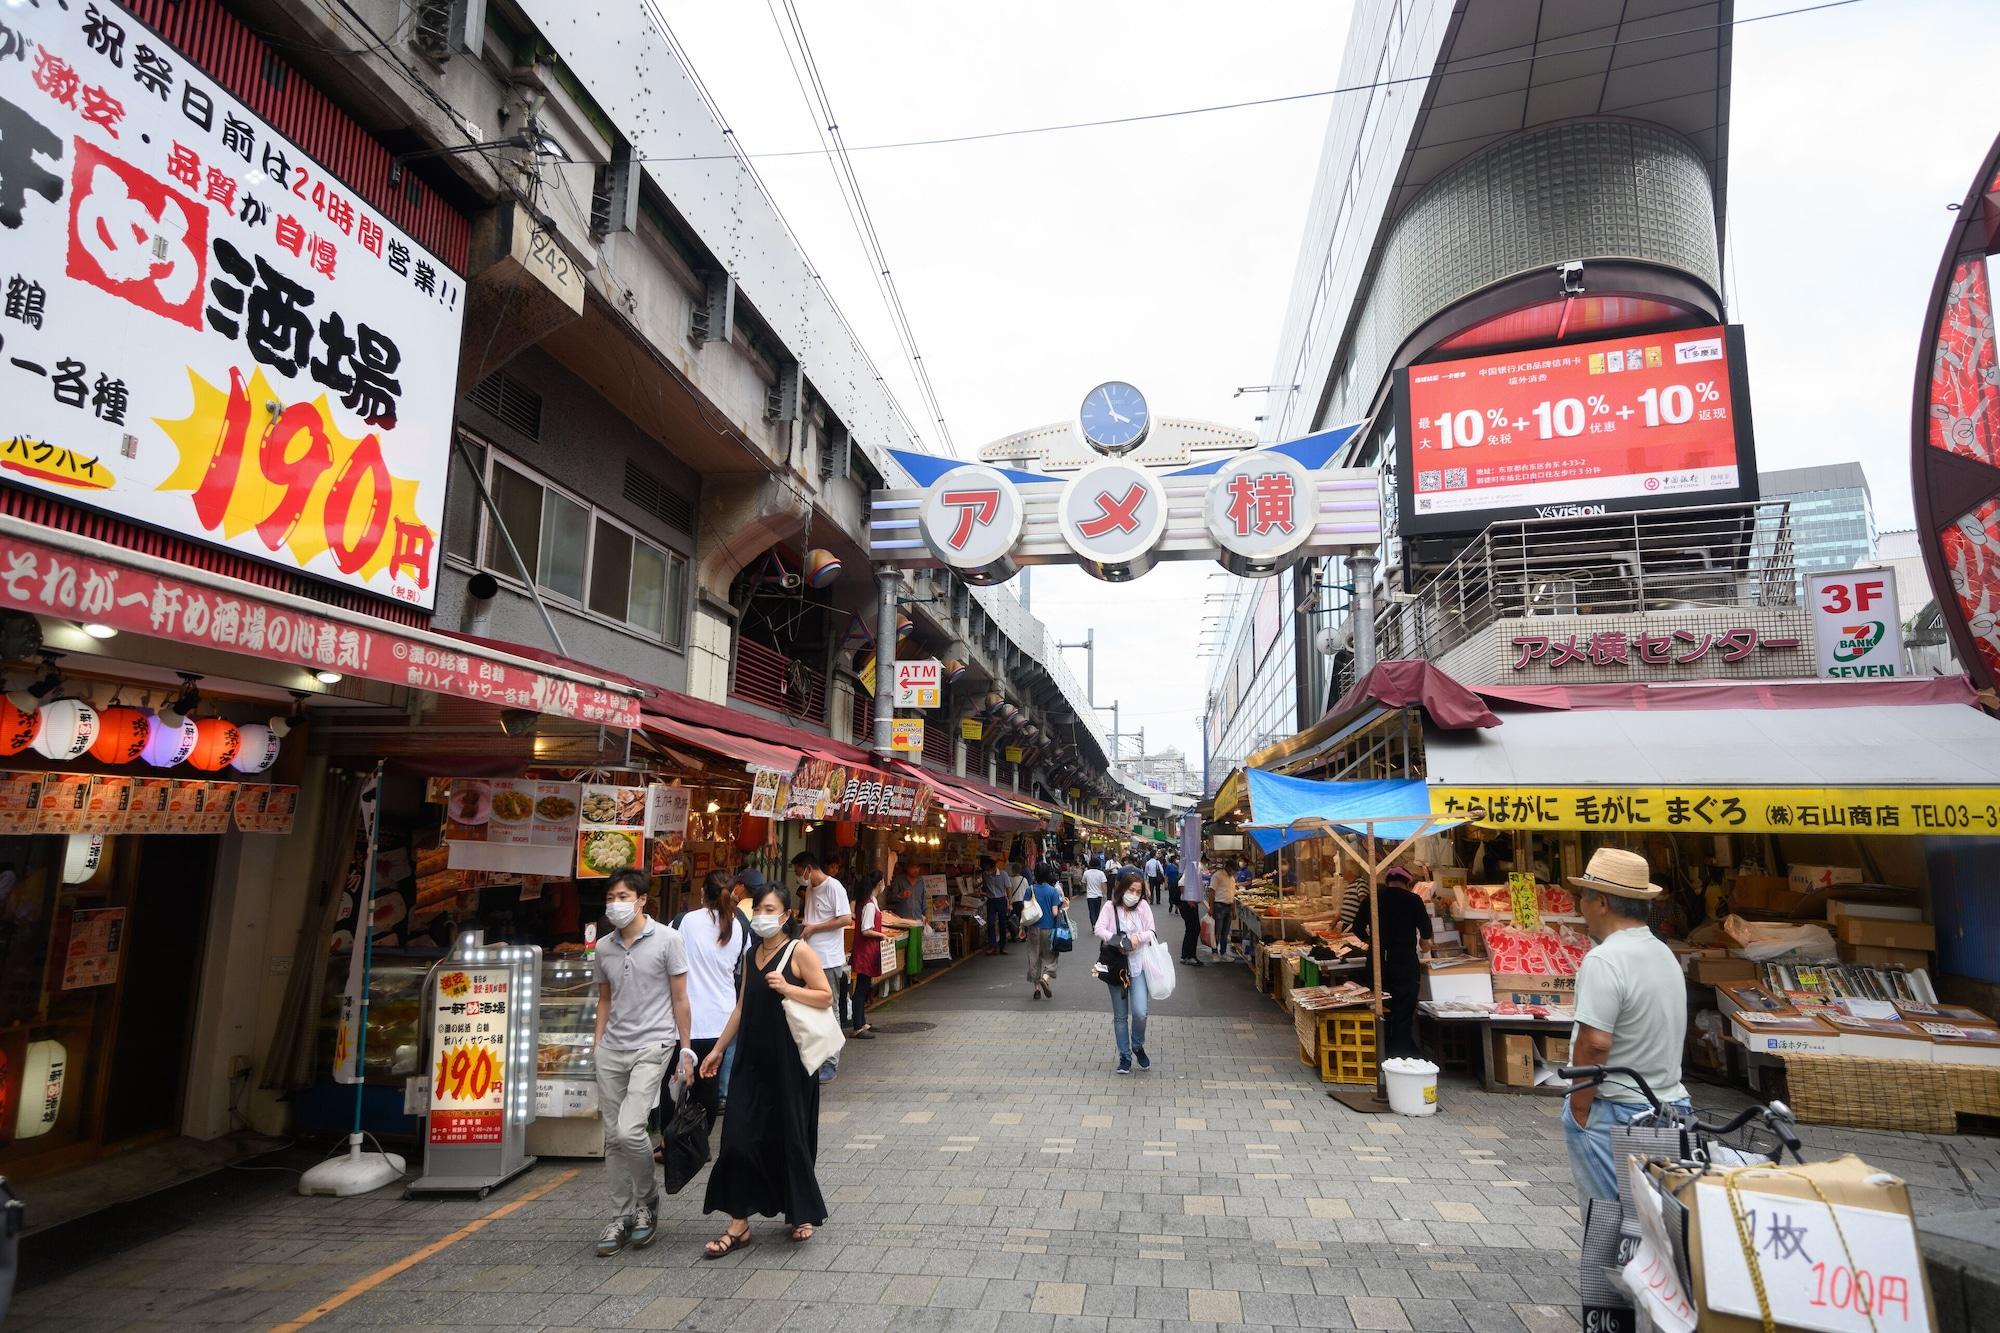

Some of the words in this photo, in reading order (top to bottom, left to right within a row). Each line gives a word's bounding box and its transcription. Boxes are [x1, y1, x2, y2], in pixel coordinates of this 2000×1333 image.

[1478, 357, 1581, 377] 中国银行JCB品牌信用卡
[1434, 408, 1509, 450] 10%
[1532, 394, 1610, 440] 10%
[1638, 381, 1720, 428] 10%
[1698, 408, 1727, 421] 返现
[1590, 422, 1616, 434] 优惠
[1487, 433, 1512, 446] 免税
[1822, 581, 1884, 614] 3F
[1, 551, 372, 670] それが一軒め酒場の心意気!
[1512, 627, 1801, 669] アメ横センター
[1840, 638, 1874, 650] BANK
[899, 665, 936, 678] ATM
[1828, 664, 1894, 677] SEVEN
[1575, 796, 1651, 824] 毛がに
[1665, 796, 1747, 825] まぐろ
[1809, 1261, 1910, 1321] 100円
